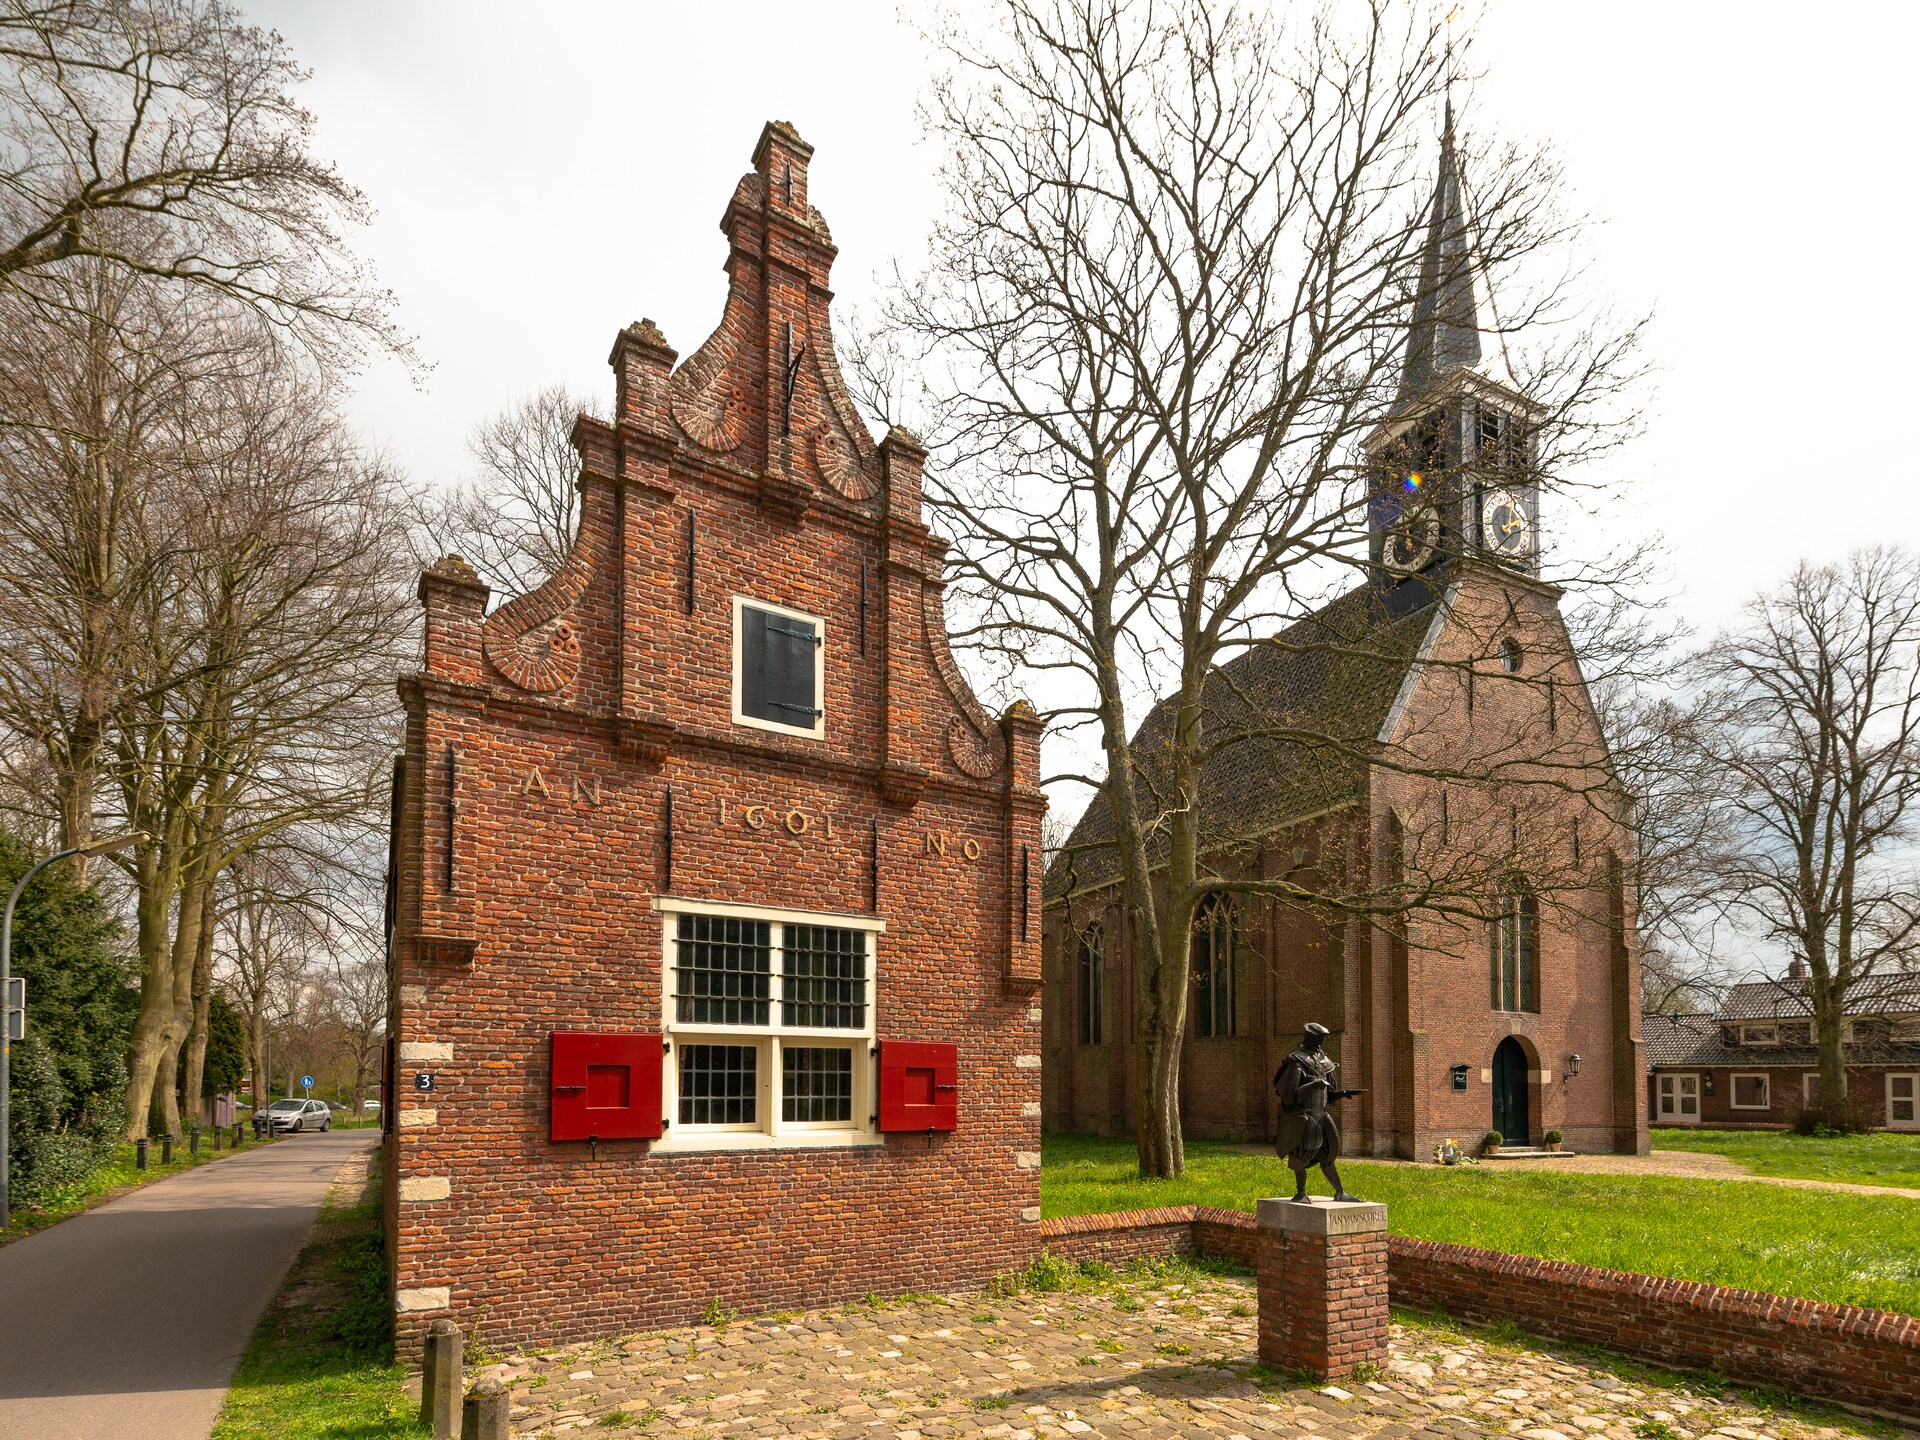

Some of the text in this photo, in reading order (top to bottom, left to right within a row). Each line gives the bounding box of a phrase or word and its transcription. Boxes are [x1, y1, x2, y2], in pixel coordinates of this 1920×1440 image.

[523, 766, 600, 805] AN
[926, 831, 981, 860] NO
[420, 1074, 431, 1088] 3
[1329, 1210, 1386, 1227] JAN VAN SCOREL
